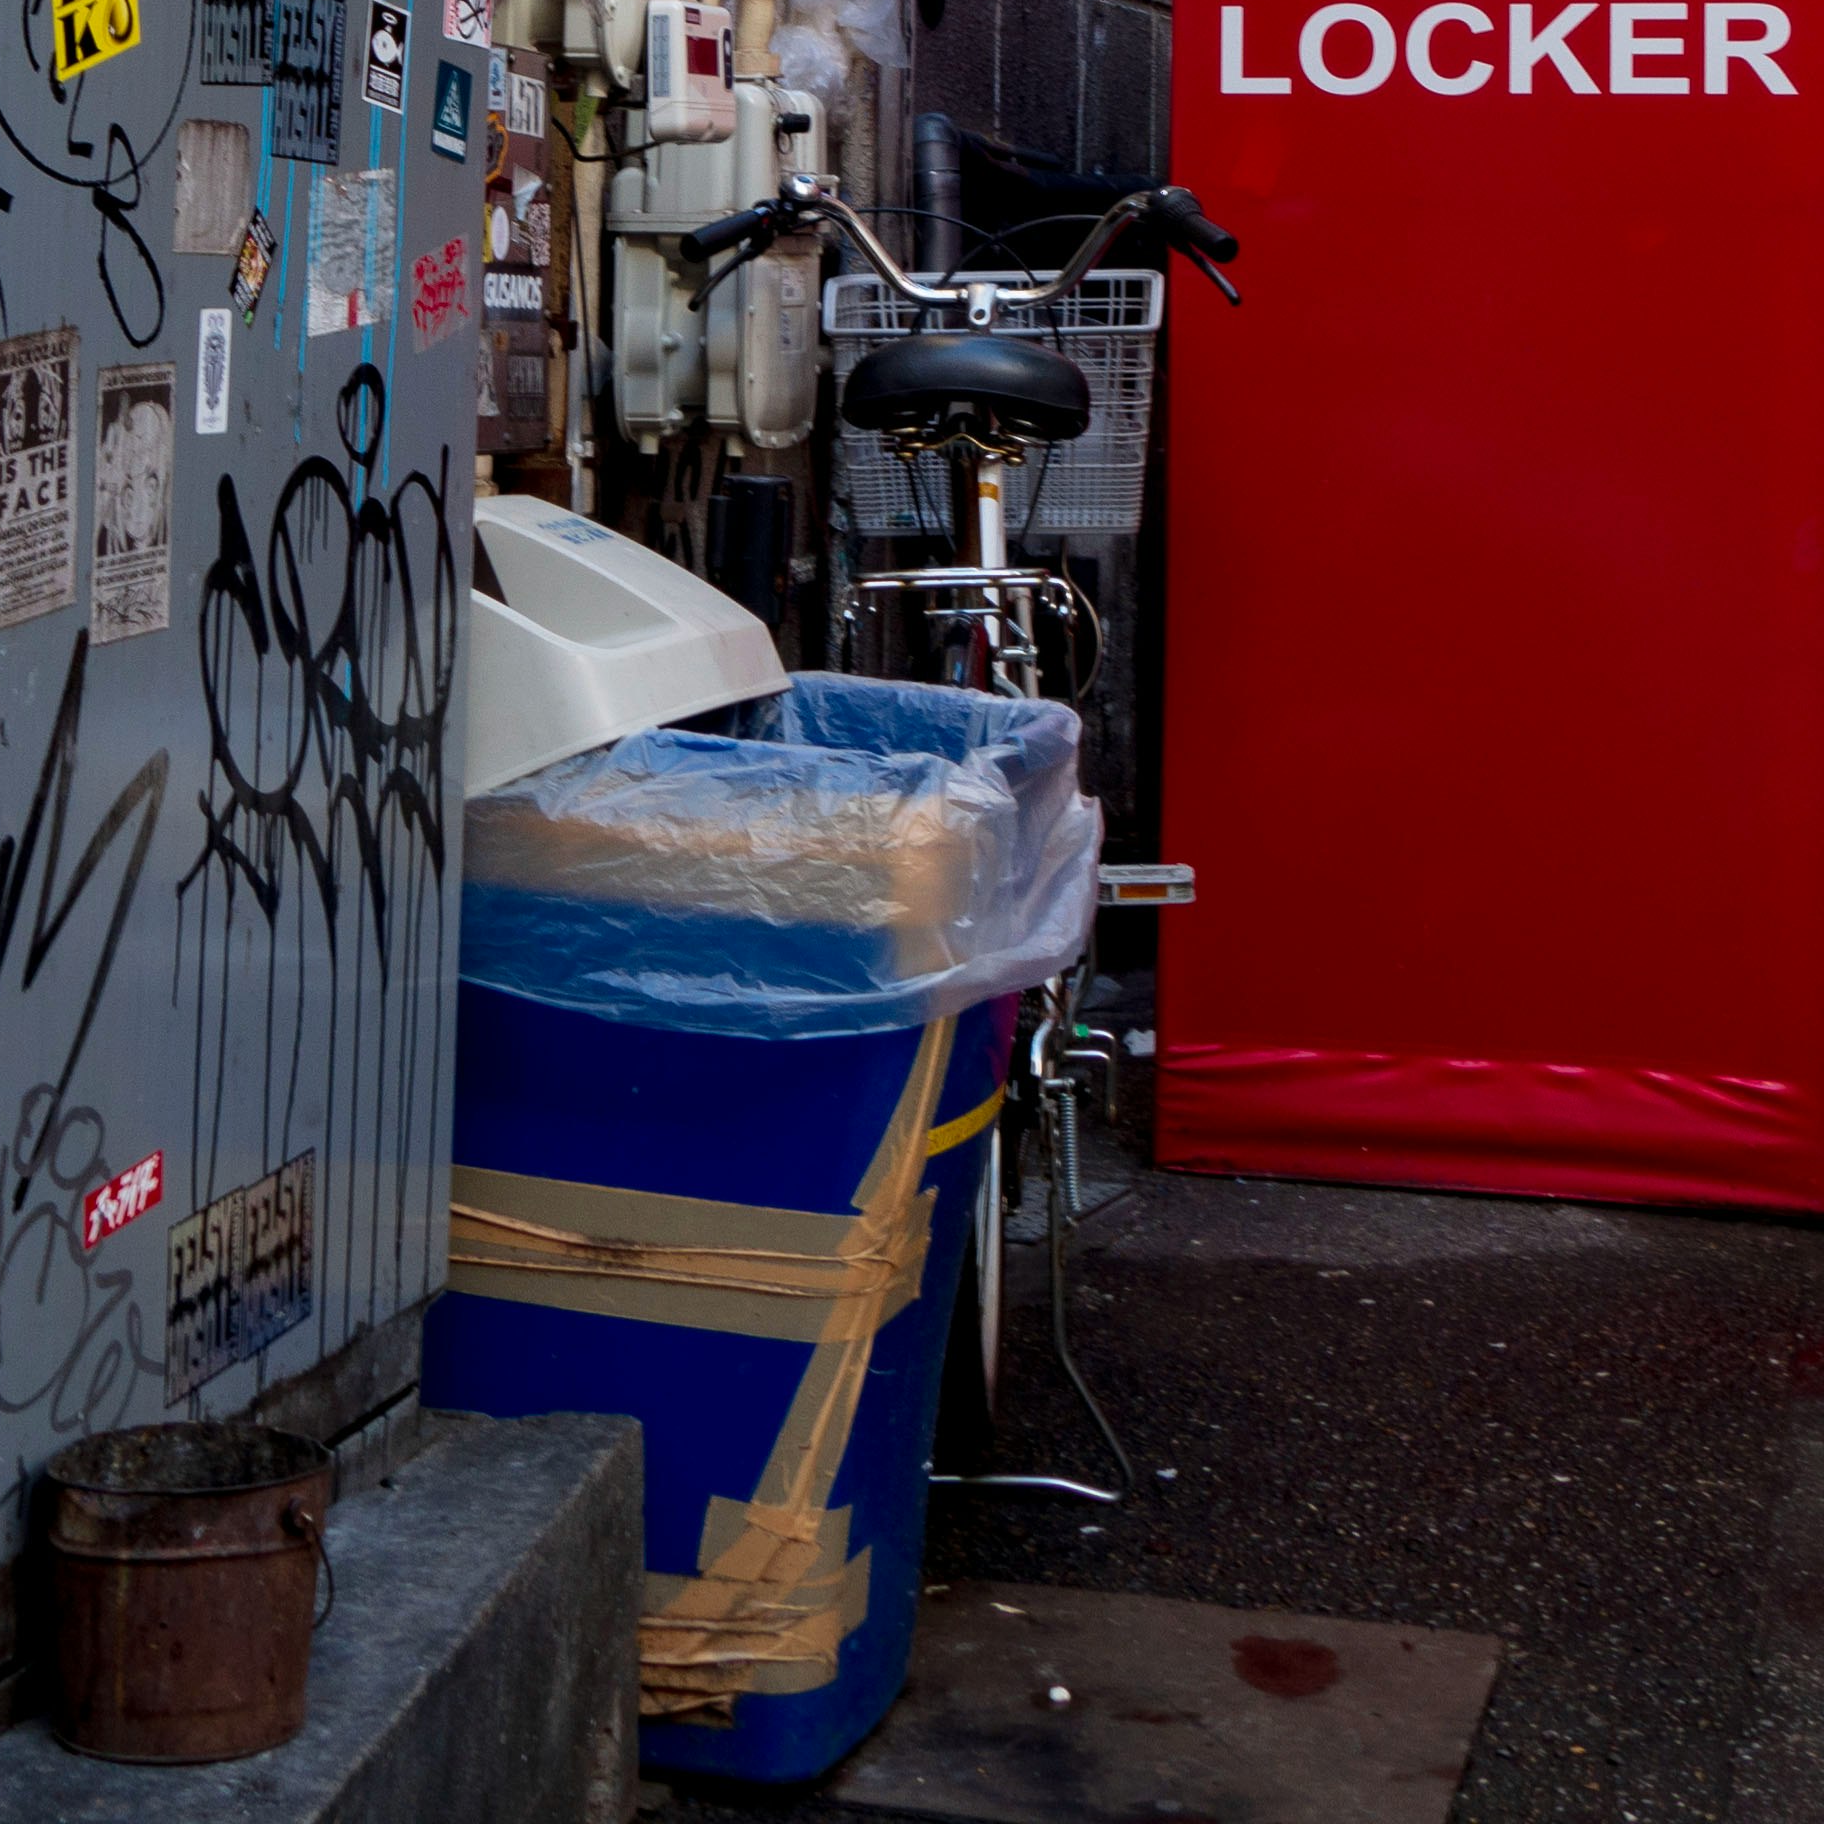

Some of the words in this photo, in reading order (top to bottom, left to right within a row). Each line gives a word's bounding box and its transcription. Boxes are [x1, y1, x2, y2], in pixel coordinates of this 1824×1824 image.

[1218, 1, 1799, 97] LOCKER
[484, 271, 544, 311] GUSANOS
[28, 443, 68, 477] THE
